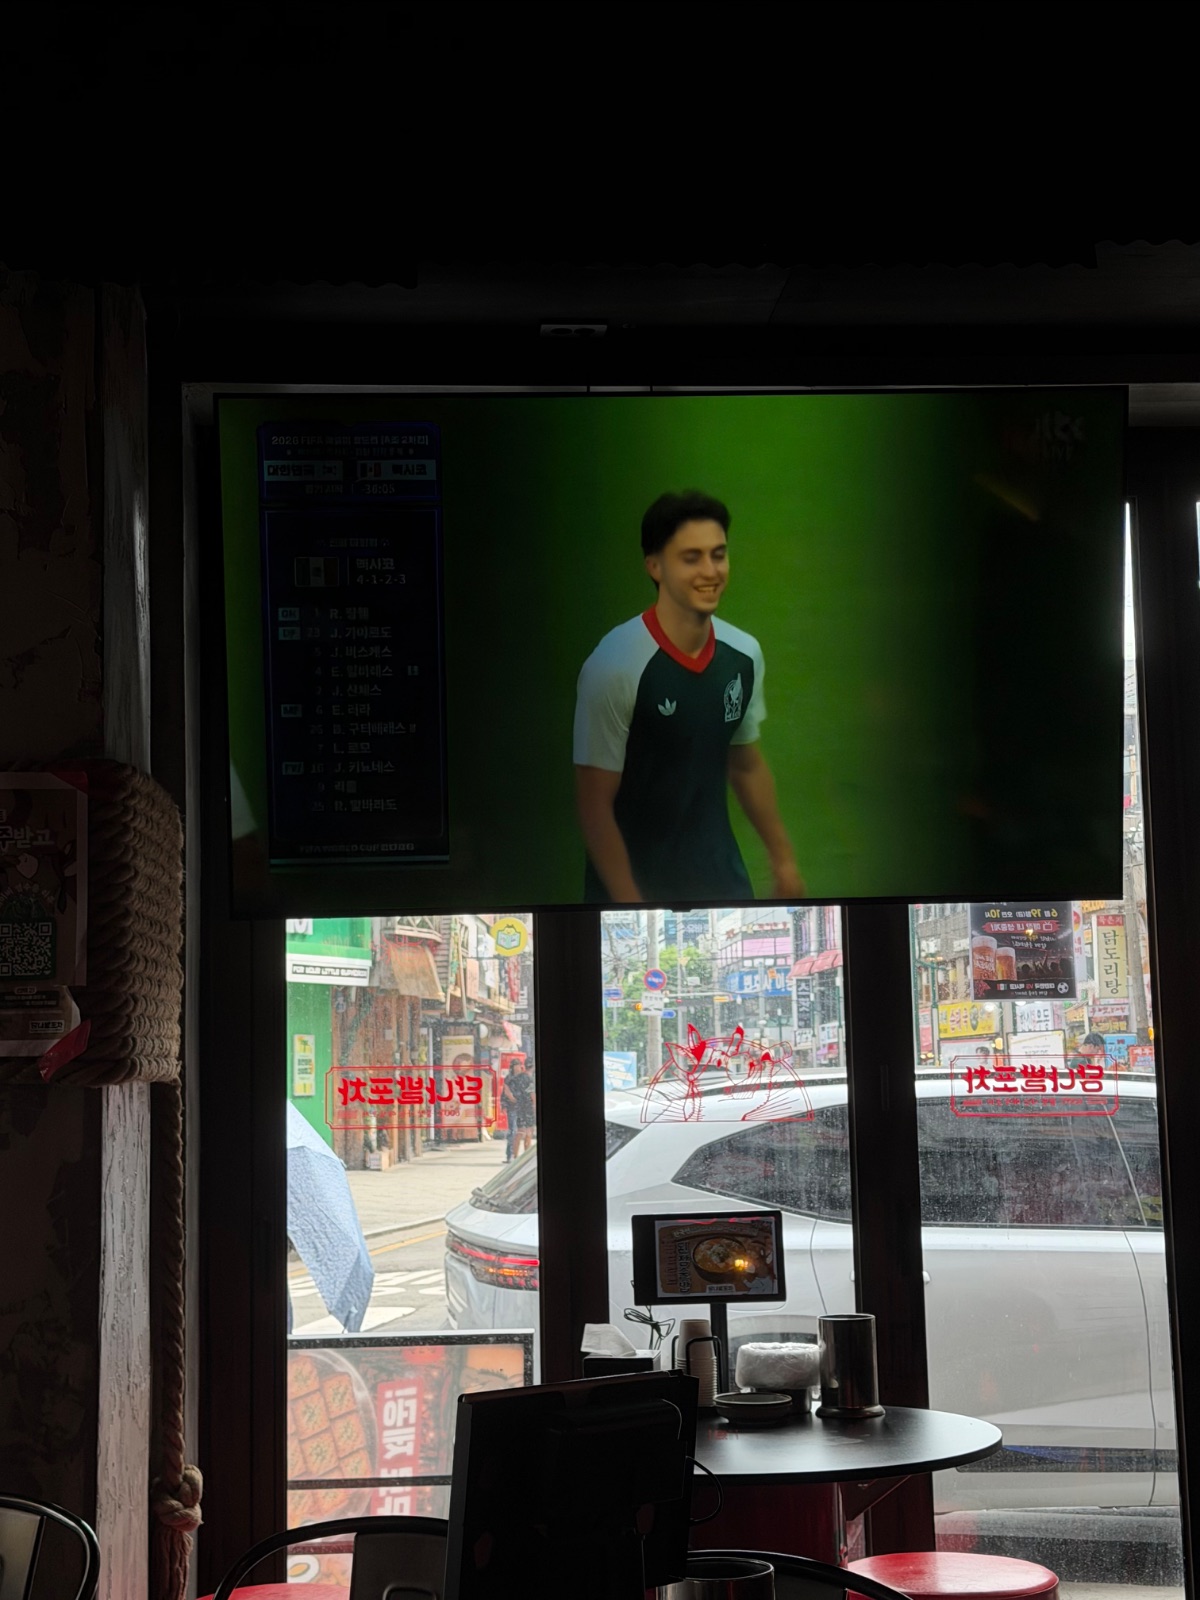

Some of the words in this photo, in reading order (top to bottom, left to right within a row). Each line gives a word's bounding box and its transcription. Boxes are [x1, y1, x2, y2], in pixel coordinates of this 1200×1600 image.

[271, 436, 299, 446] 2026
[266, 464, 315, 477] 대한민국
[392, 464, 427, 476] 멕시코
[356, 557, 395, 571] 멕시코
[356, 574, 406, 585] 4-1-2-3
[330, 628, 342, 639] J.
[330, 647, 342, 658] J.
[331, 666, 344, 677] E.
[332, 686, 343, 696] J.
[346, 684, 382, 697] 산체스
[332, 704, 344, 716] E.
[347, 742, 372, 754] 로모
[334, 762, 345, 773] J.
[1102, 929, 1122, 995] 닭도리탕
